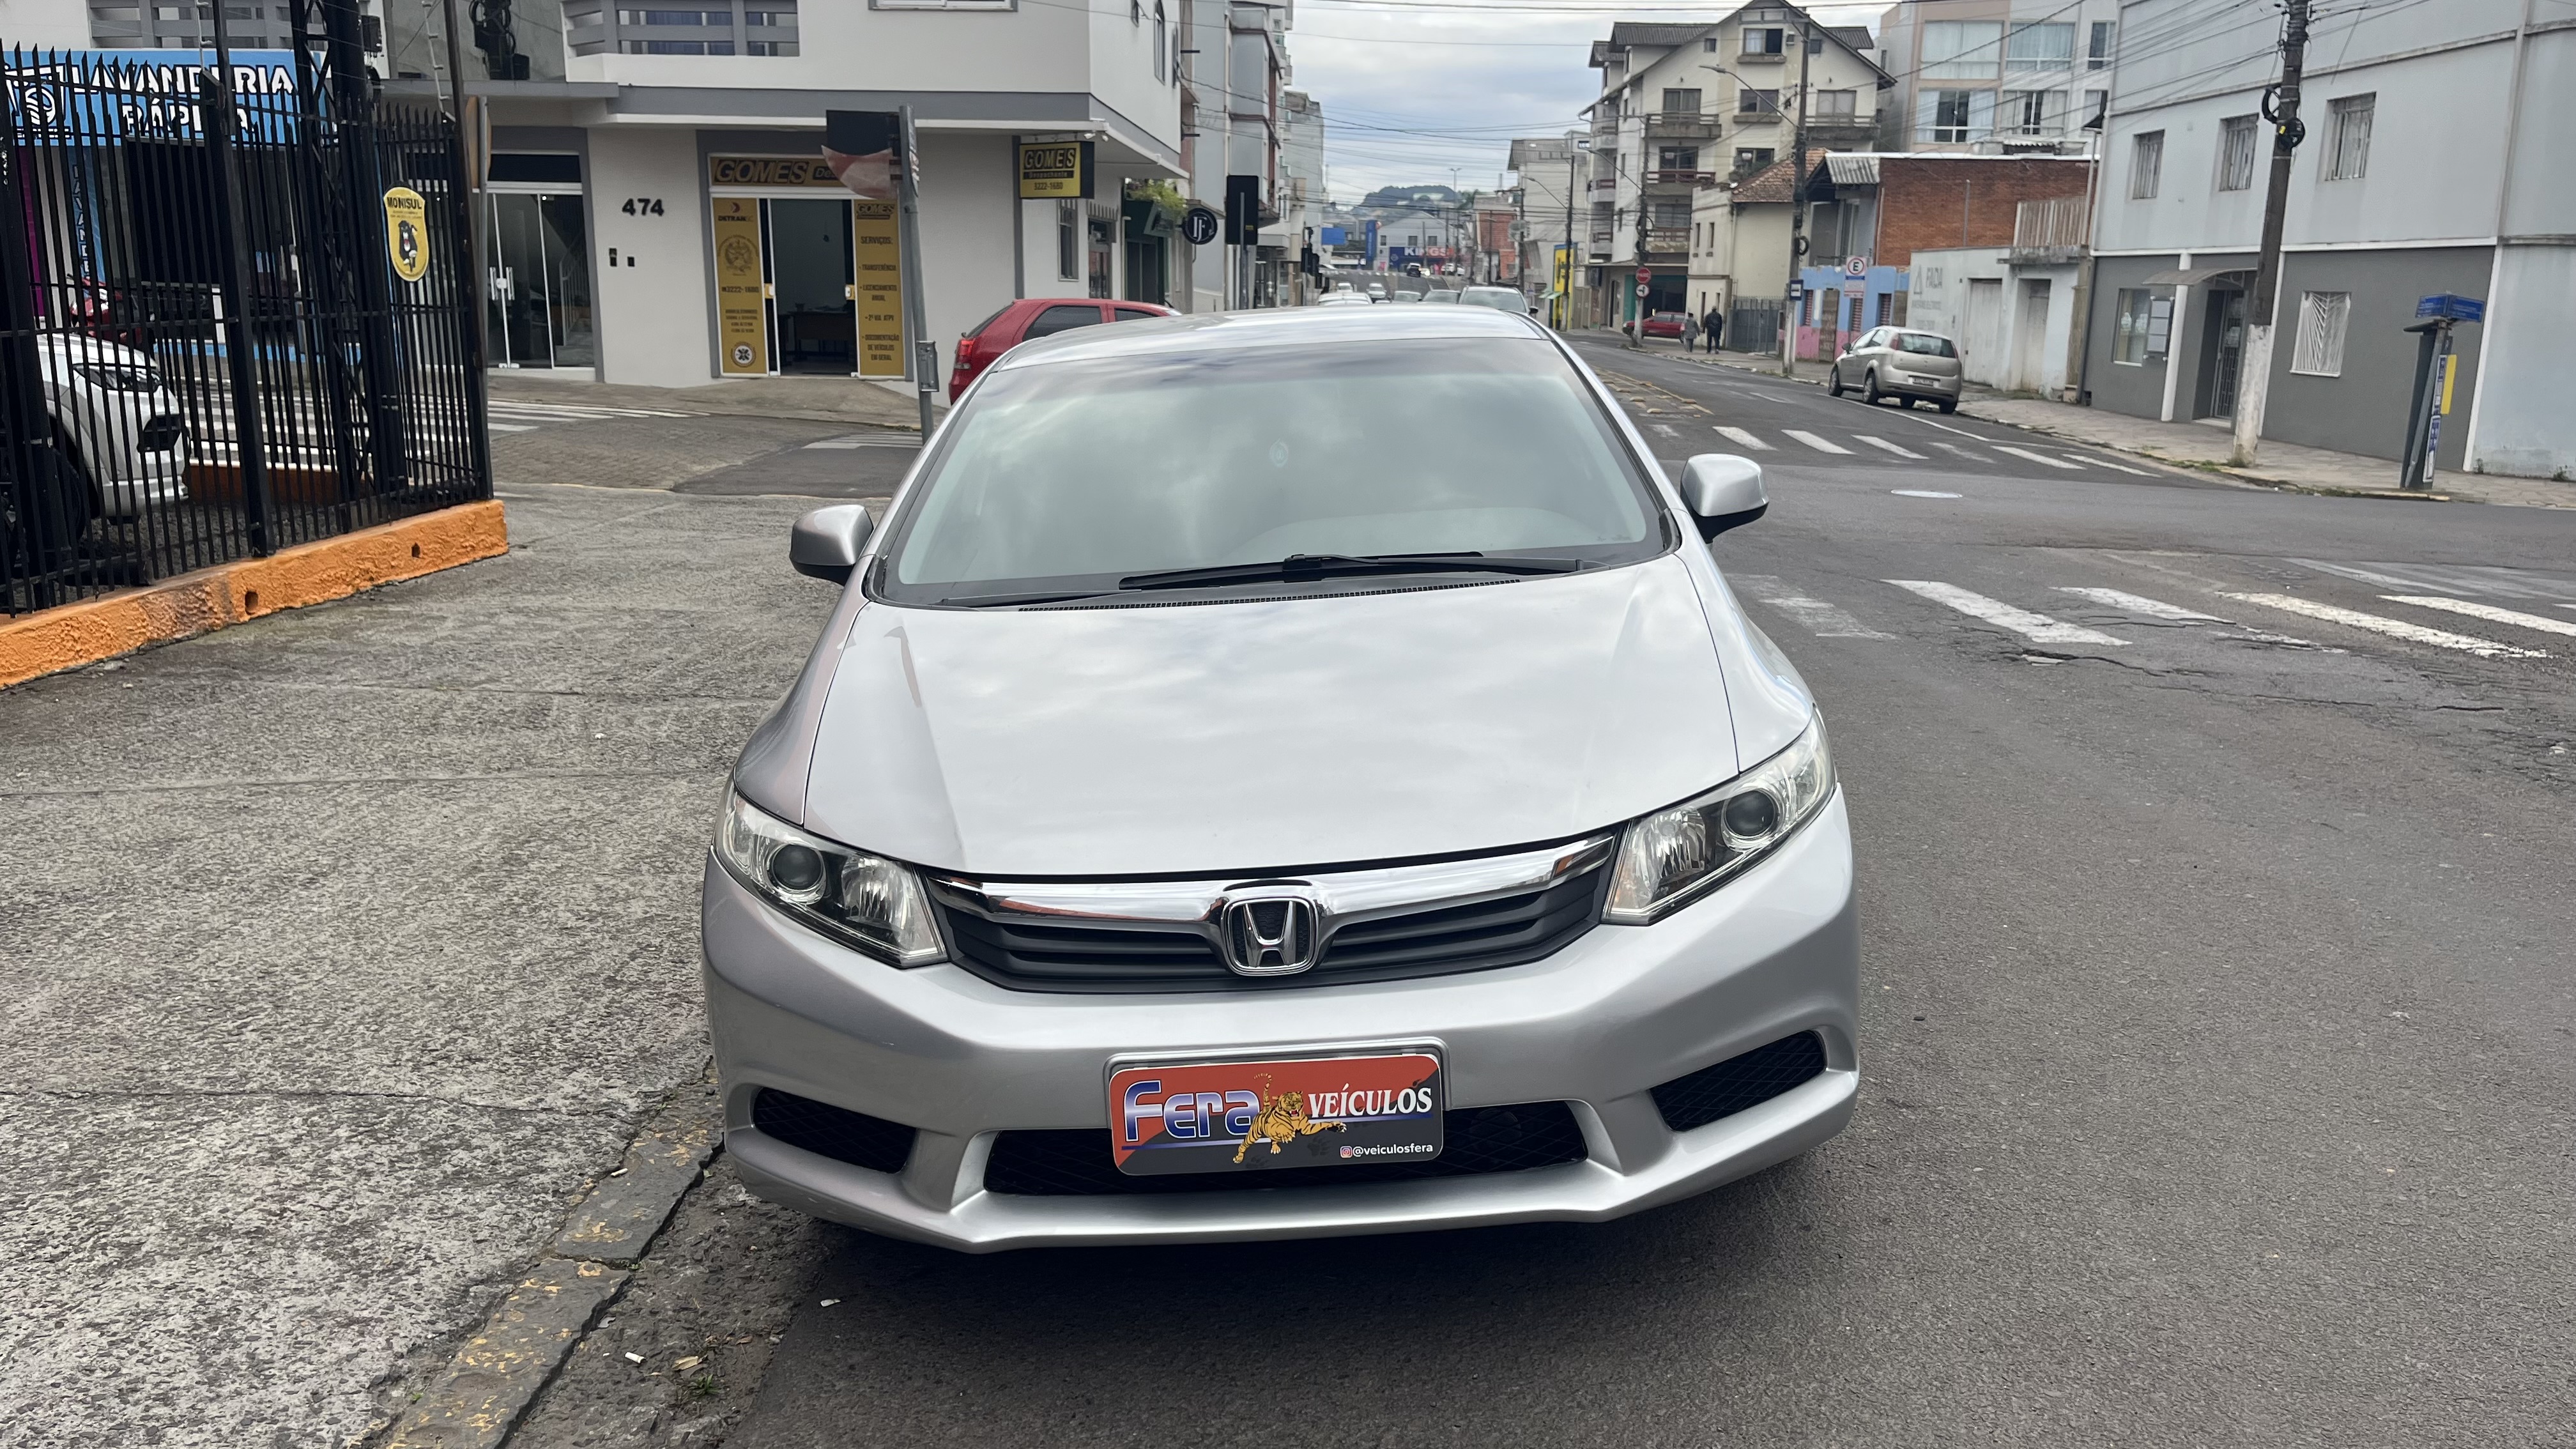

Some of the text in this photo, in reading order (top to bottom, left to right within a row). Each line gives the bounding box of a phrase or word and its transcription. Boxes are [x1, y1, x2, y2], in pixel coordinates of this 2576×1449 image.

[1024, 150, 1075, 168] GOMES
[716, 160, 809, 183] GOMES
[387, 197, 422, 209] MONISUL
[622, 198, 664, 216] 474
[1853, 262, 1859, 272] E
[1123, 1079, 1432, 1142] Fera VEÍCULOS
[1353, 1143, 1433, 1157] @veiculosfera
